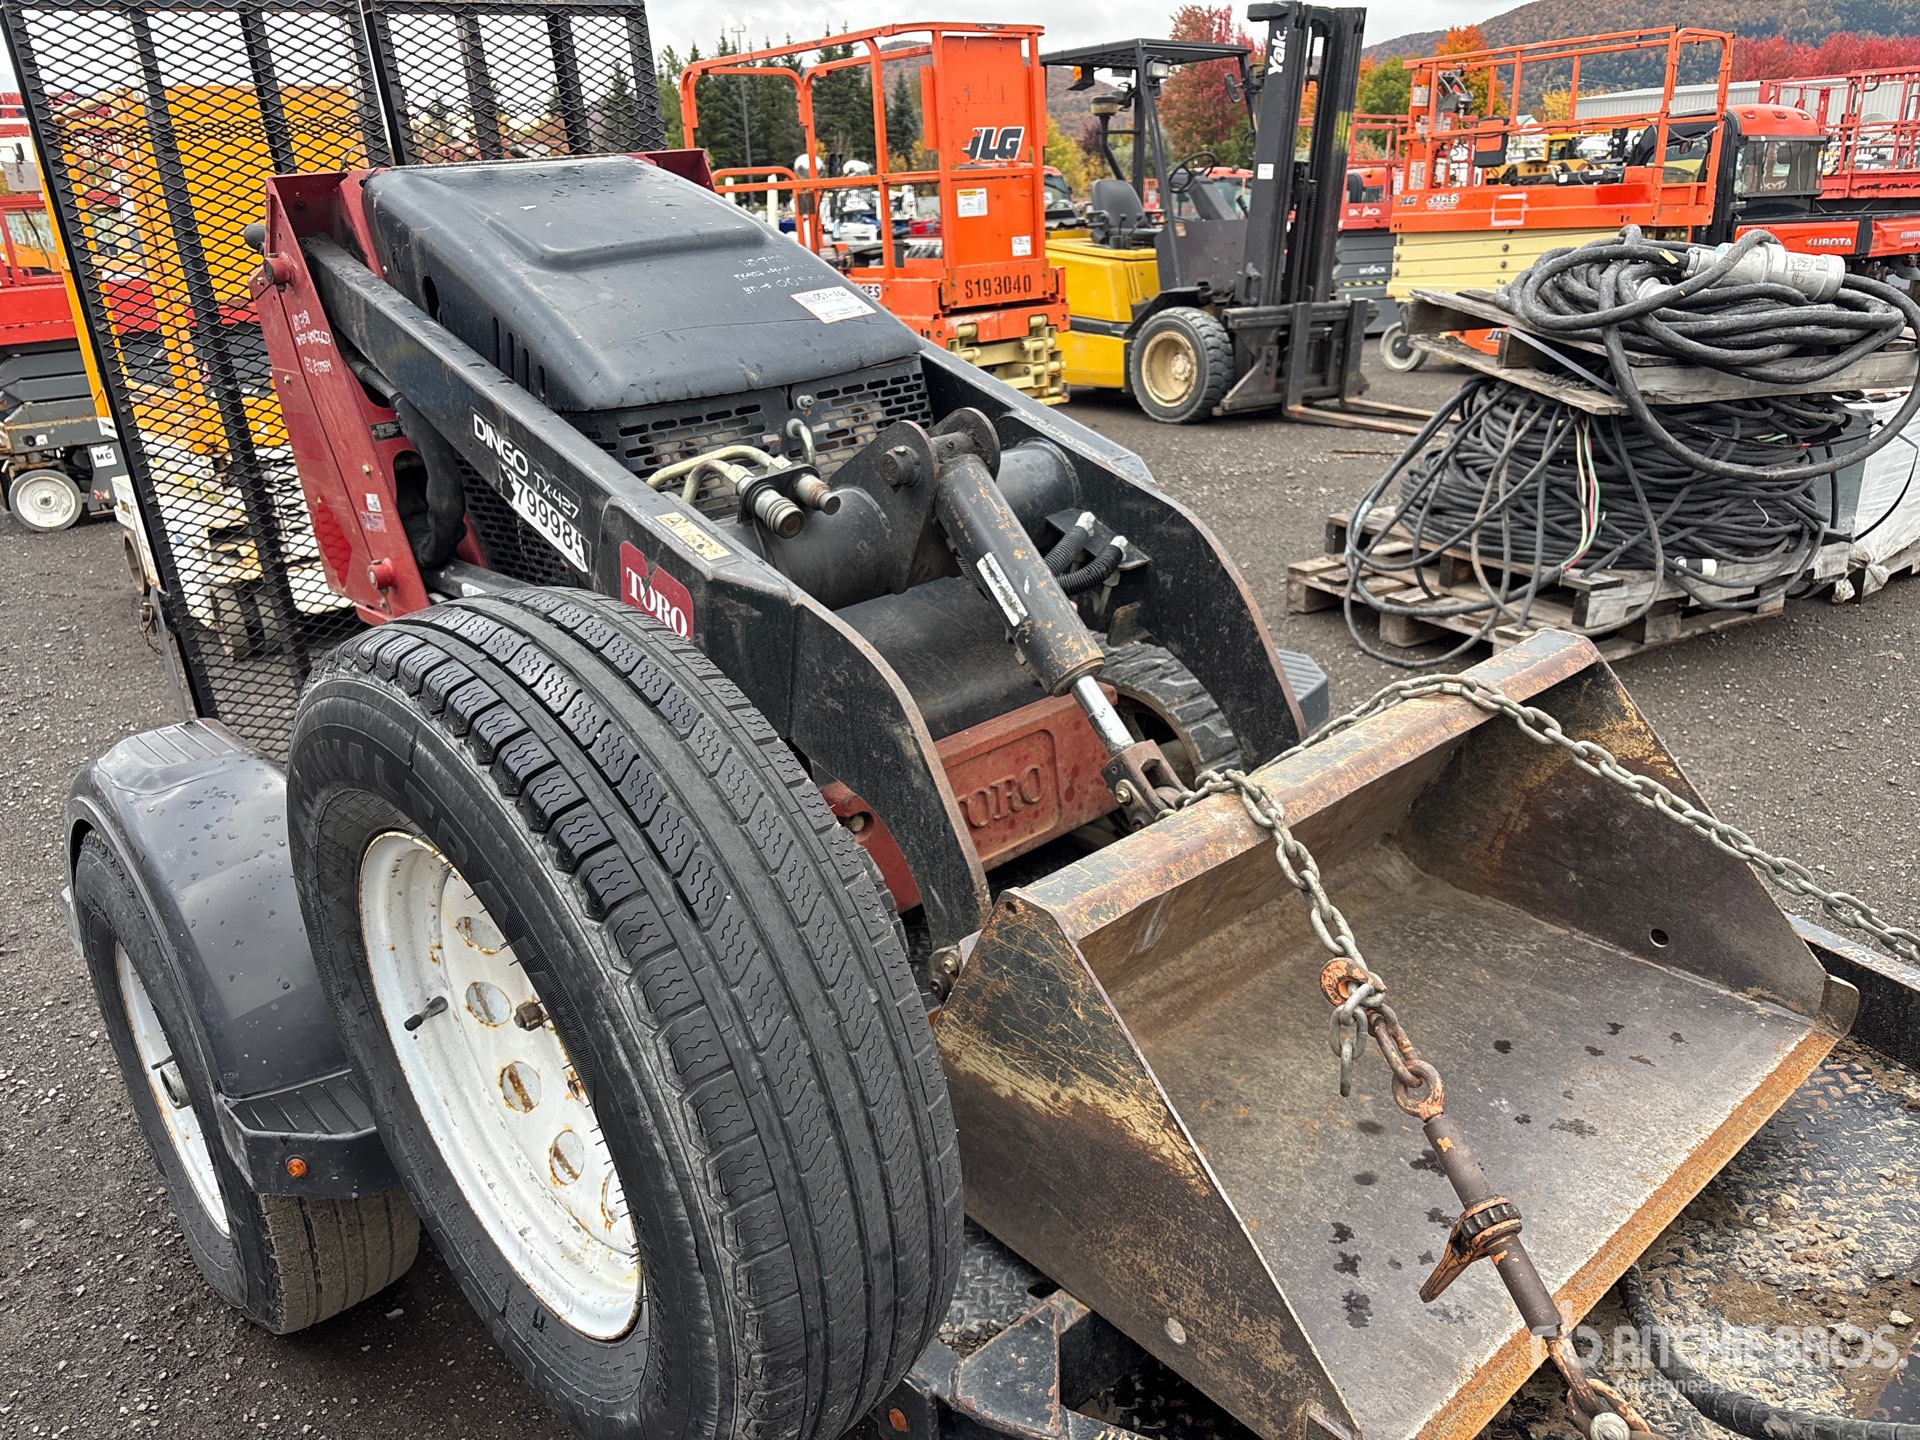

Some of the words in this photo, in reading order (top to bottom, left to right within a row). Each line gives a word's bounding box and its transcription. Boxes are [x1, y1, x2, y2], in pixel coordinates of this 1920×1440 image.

[962, 126, 1025, 160] JLG
[1805, 237, 1852, 248] KUBOTA
[965, 274, 1032, 299] S193040
[473, 413, 529, 477] DINGO
[626, 566, 688, 637] TORO
